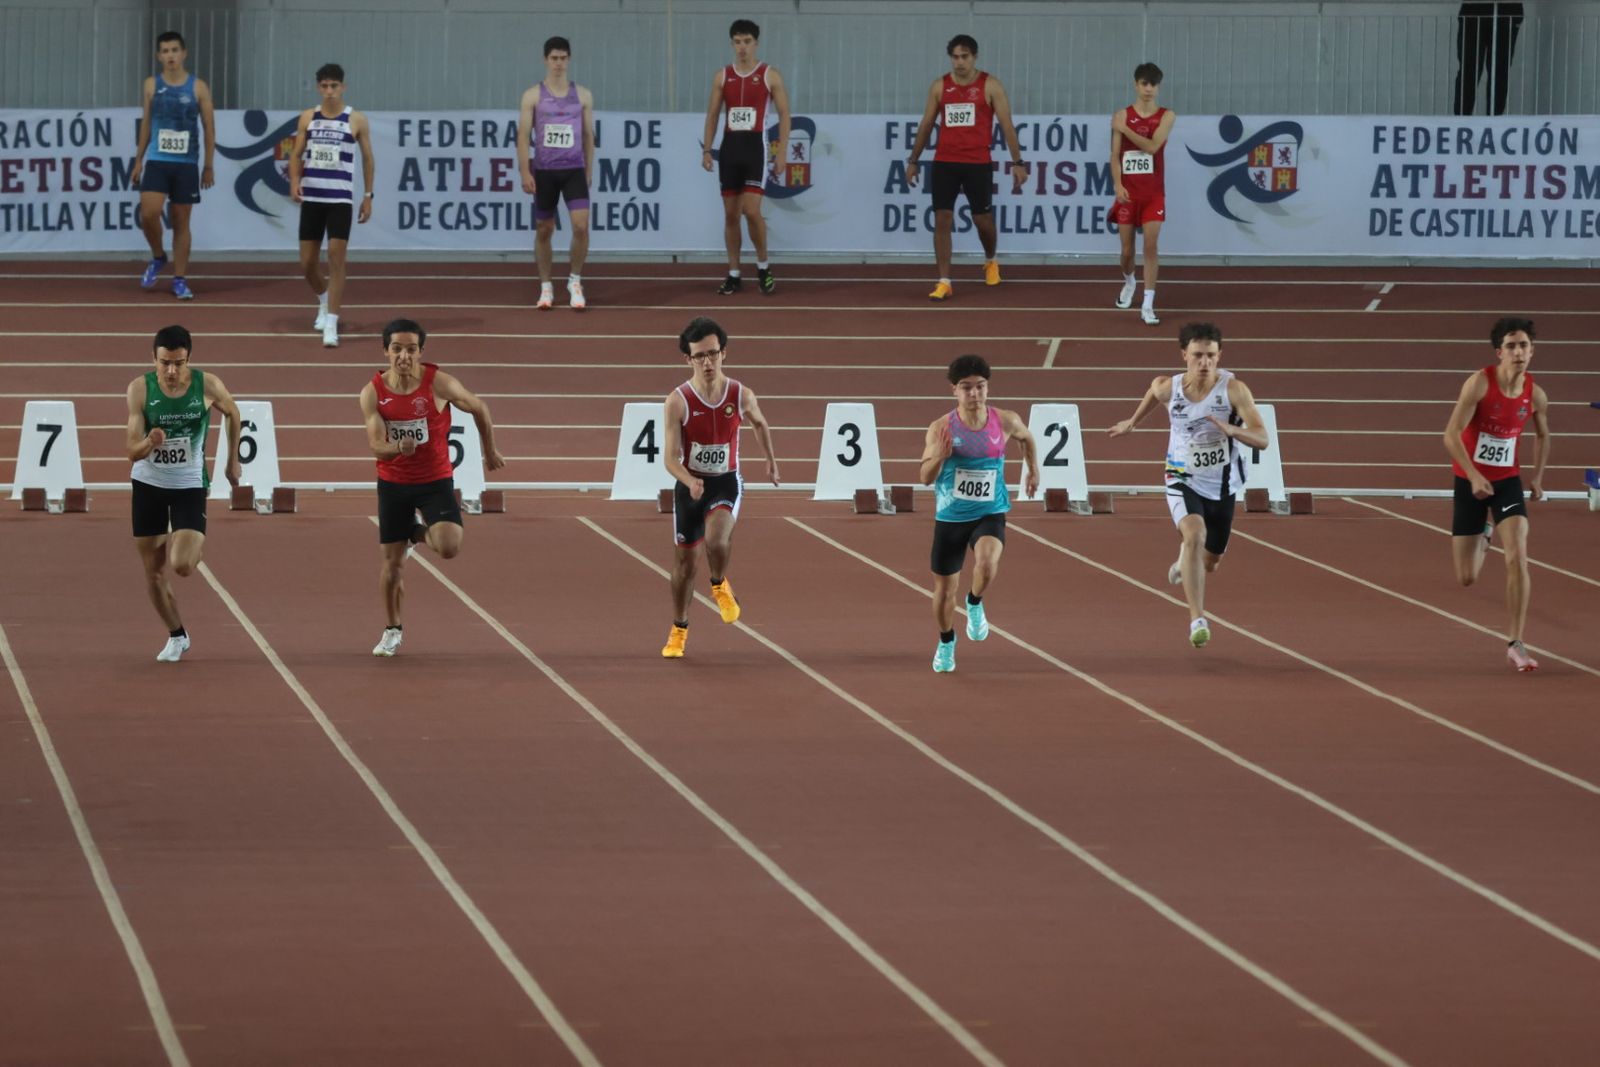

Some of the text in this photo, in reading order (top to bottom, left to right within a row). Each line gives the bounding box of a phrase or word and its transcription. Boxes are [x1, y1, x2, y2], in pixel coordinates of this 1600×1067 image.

[731, 112, 751, 123] 3641
[948, 111, 971, 123] 3897
[161, 137, 185, 151] 2833
[546, 132, 571, 144] 3717
[624, 120, 661, 148] DE
[1373, 121, 1578, 155] FEDERACIÓN
[398, 157, 661, 193] ATLEMO
[1125, 159, 1149, 171] 2766
[80, 202, 97, 231] Y
[398, 201, 431, 230] DE
[592, 197, 660, 231] LEÓN
[883, 204, 916, 232] DE
[1053, 206, 1070, 234] Y
[1369, 208, 1600, 239] DE CASTILLA Y LE
[160, 411, 201, 420] universidad
[36, 424, 63, 467] 7
[238, 420, 258, 465] 6
[391, 427, 424, 441] 3896
[631, 420, 659, 463] 4
[836, 423, 862, 467] 3
[1043, 423, 1069, 467] 2
[153, 448, 187, 464] 2882
[695, 450, 726, 464] 4909
[1193, 448, 1226, 468] 3382
[1478, 443, 1510, 463] 2951
[957, 480, 991, 497] 4082
